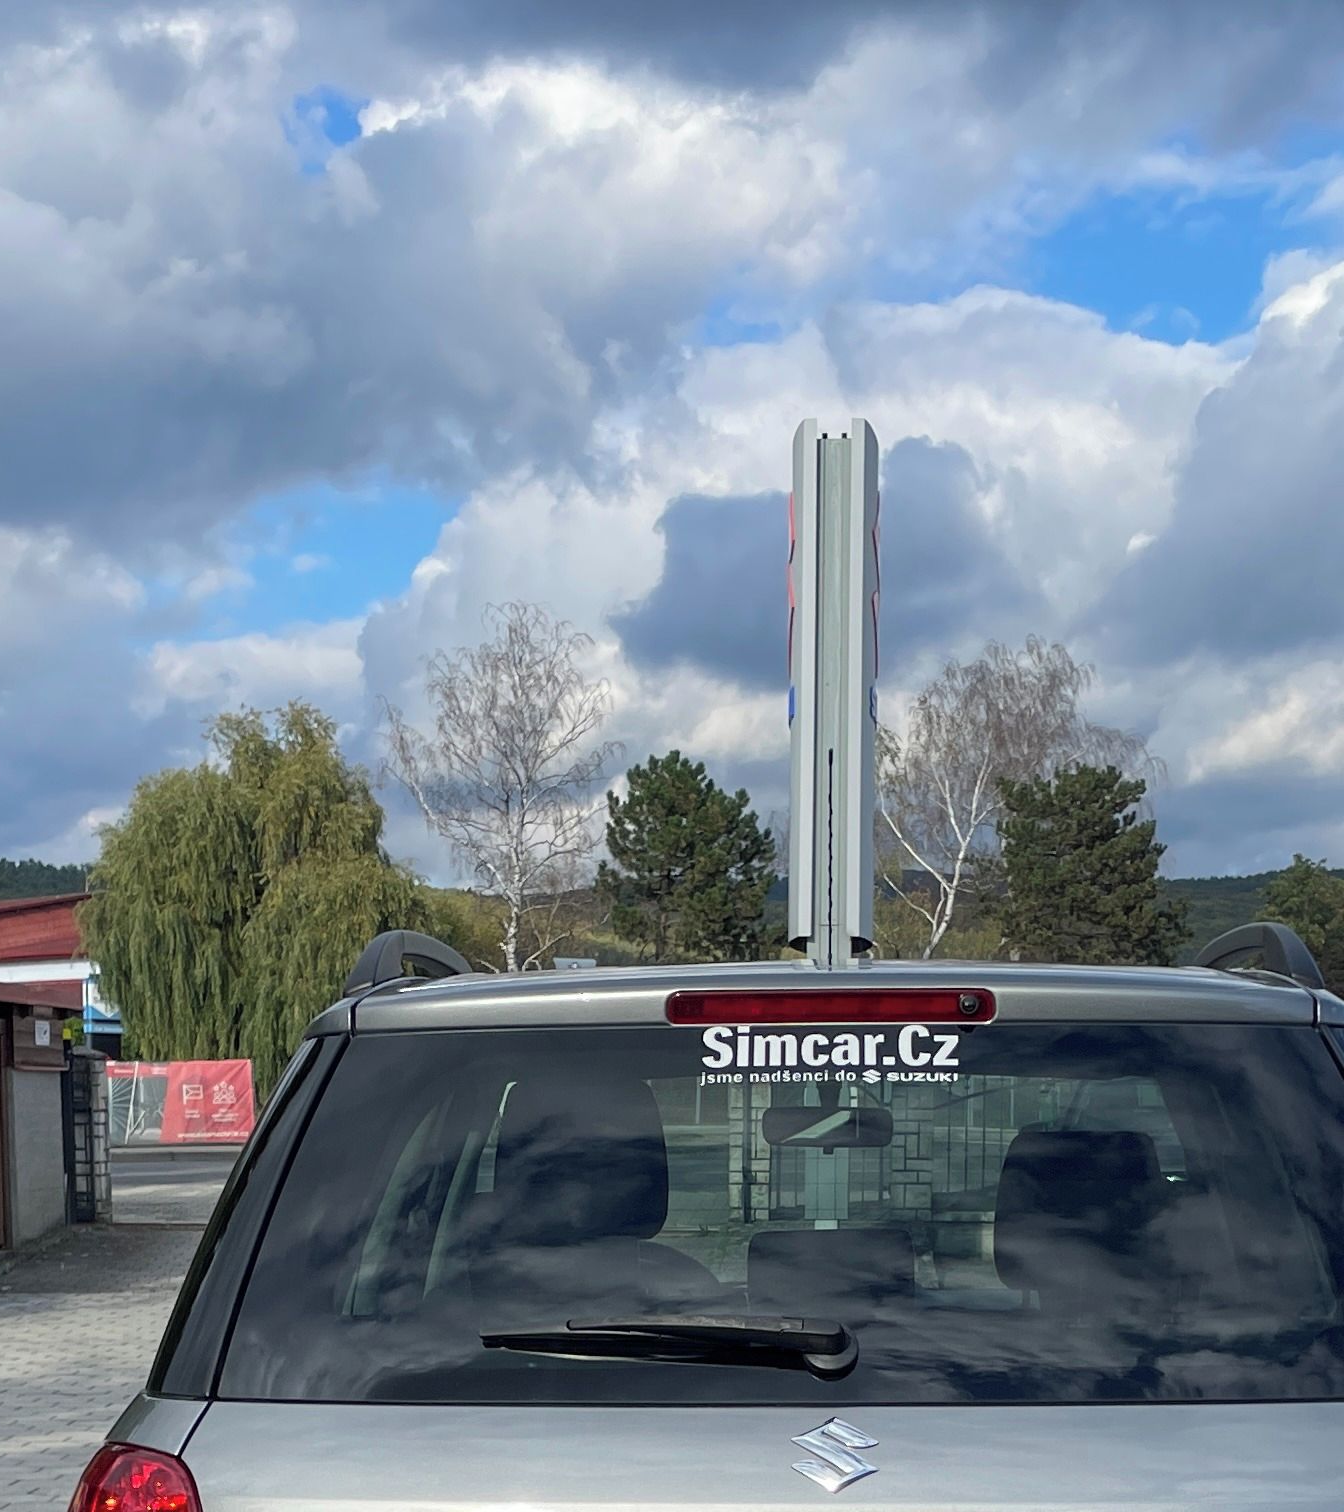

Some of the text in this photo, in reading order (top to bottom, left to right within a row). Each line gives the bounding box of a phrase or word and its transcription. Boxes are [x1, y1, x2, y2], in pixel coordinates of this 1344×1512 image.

[701, 1024, 960, 1069] Simcar.Cz
[699, 1069, 959, 1087] jsme nadšenci do SUZUKI
